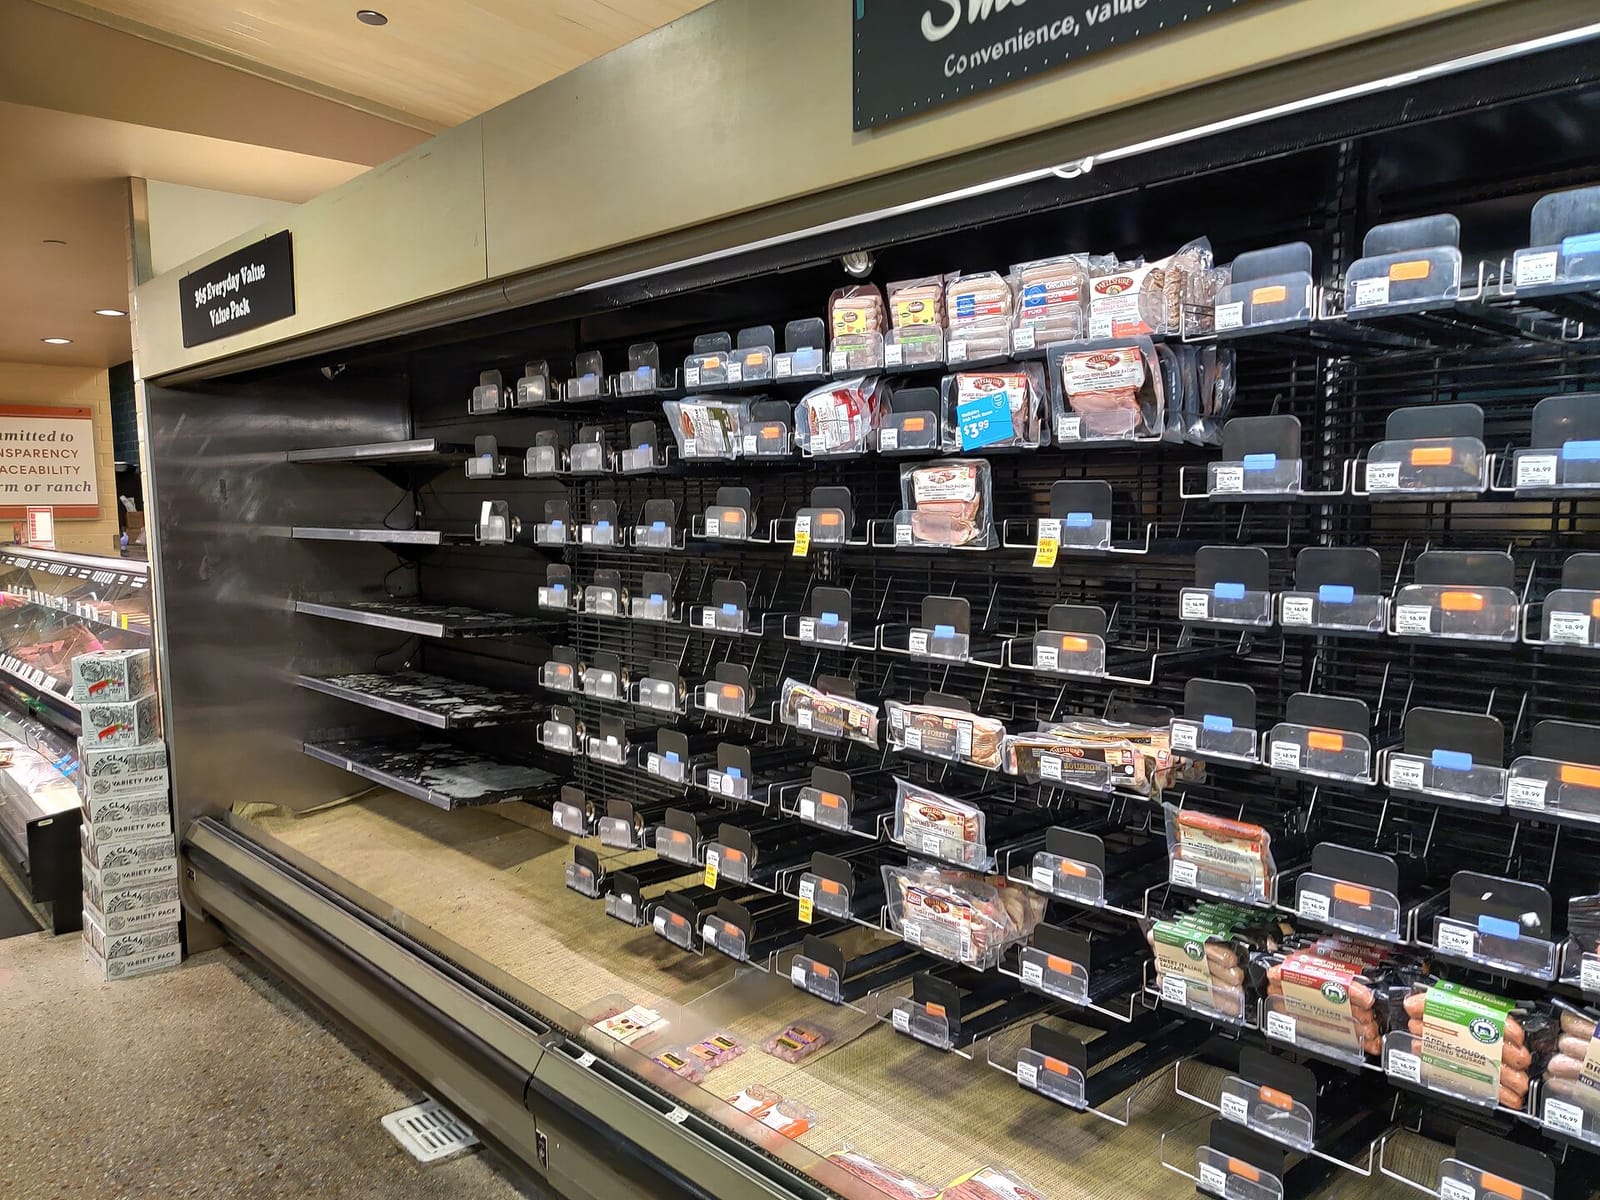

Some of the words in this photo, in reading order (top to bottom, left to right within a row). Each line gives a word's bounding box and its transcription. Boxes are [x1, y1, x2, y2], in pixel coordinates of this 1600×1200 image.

[944, 16, 1080, 77] Convenience,
[1085, 0, 1147, 27] value
[194, 287, 206, 308] 365
[206, 272, 240, 298] Everyday
[240, 262, 266, 285] Value
[209, 306, 230, 328] Value
[230, 297, 250, 320] Pack
[0, 430, 56, 442] mitted
[60, 432, 74, 442] to
[24, 483, 41, 492] or
[46, 480, 92, 492] ranch
[928, 730, 948, 738] FOREST
[1064, 762, 1100, 770] BOURBON
[112, 778, 142, 787] VARIETY
[144, 775, 164, 783] PACK
[114, 824, 144, 833] VARIETY
[147, 821, 166, 830] PACK
[1205, 850, 1237, 864] SAUSAGE
[122, 868, 152, 878] VARIETY
[154, 864, 172, 873] PACK
[126, 911, 156, 922] VARIETY
[158, 908, 176, 916] PACK
[1452, 937, 1469, 946] $6.99
[126, 956, 156, 967] VARIETY
[158, 952, 176, 961] PACK
[1159, 957, 1178, 966] SWEET
[1180, 962, 1202, 972] ITALIAN
[1160, 962, 1184, 972] SAUSAGE
[1310, 1005, 1341, 1016] ITALIAN
[1424, 1036, 1454, 1050] APPLE
[1454, 1045, 1486, 1060] GOUDA
[1424, 1042, 1454, 1056] UNCURED
[1456, 1050, 1486, 1066] SAUSAGE
[1422, 1055, 1433, 1063] NO
[1581, 1076, 1593, 1088] NO
[1558, 1113, 1578, 1124] $6.99
